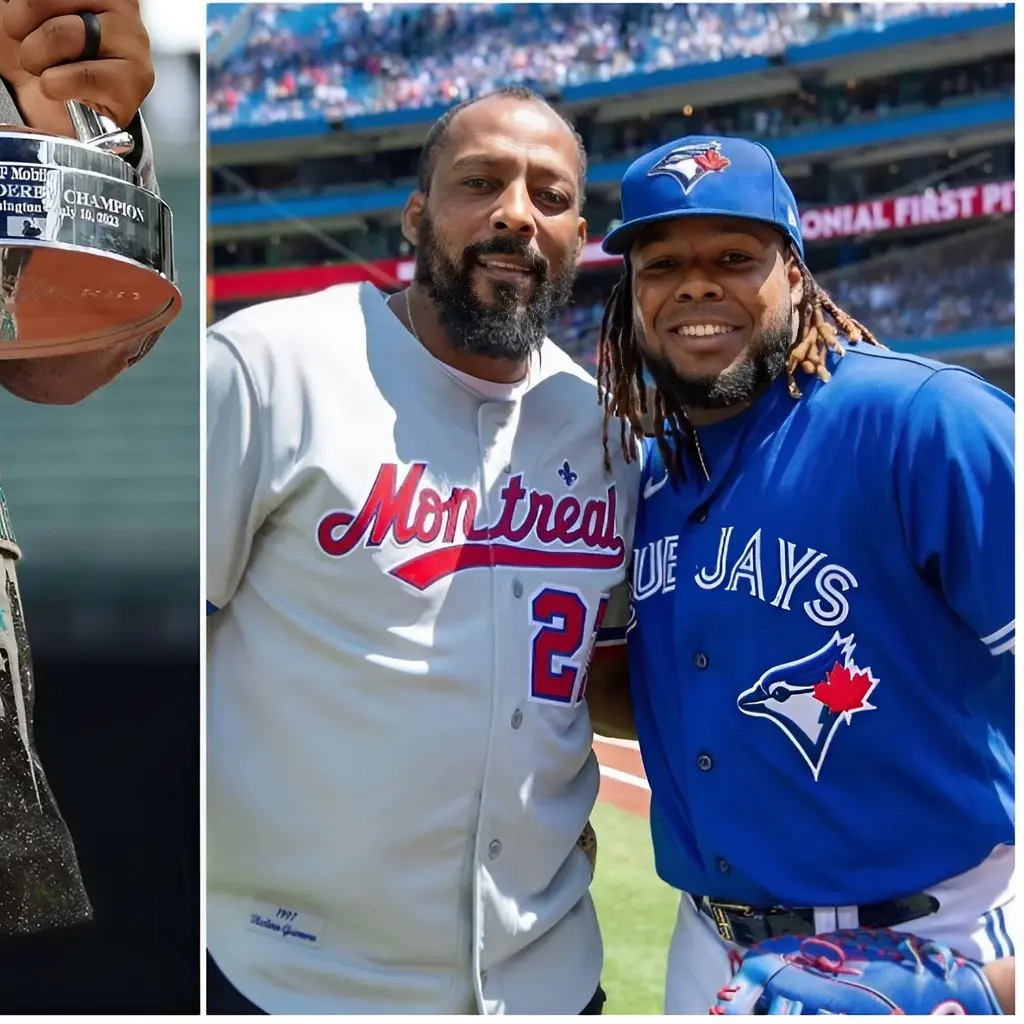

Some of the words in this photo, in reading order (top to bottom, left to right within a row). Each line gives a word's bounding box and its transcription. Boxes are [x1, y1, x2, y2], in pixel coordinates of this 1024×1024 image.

[63, 188, 145, 223] CHAMPION
[799, 199, 890, 240] ONIAL
[893, 185, 977, 228] FIRST
[318, 461, 626, 564] Montreal
[632, 533, 680, 603] UE
[694, 525, 859, 627] JAYS
